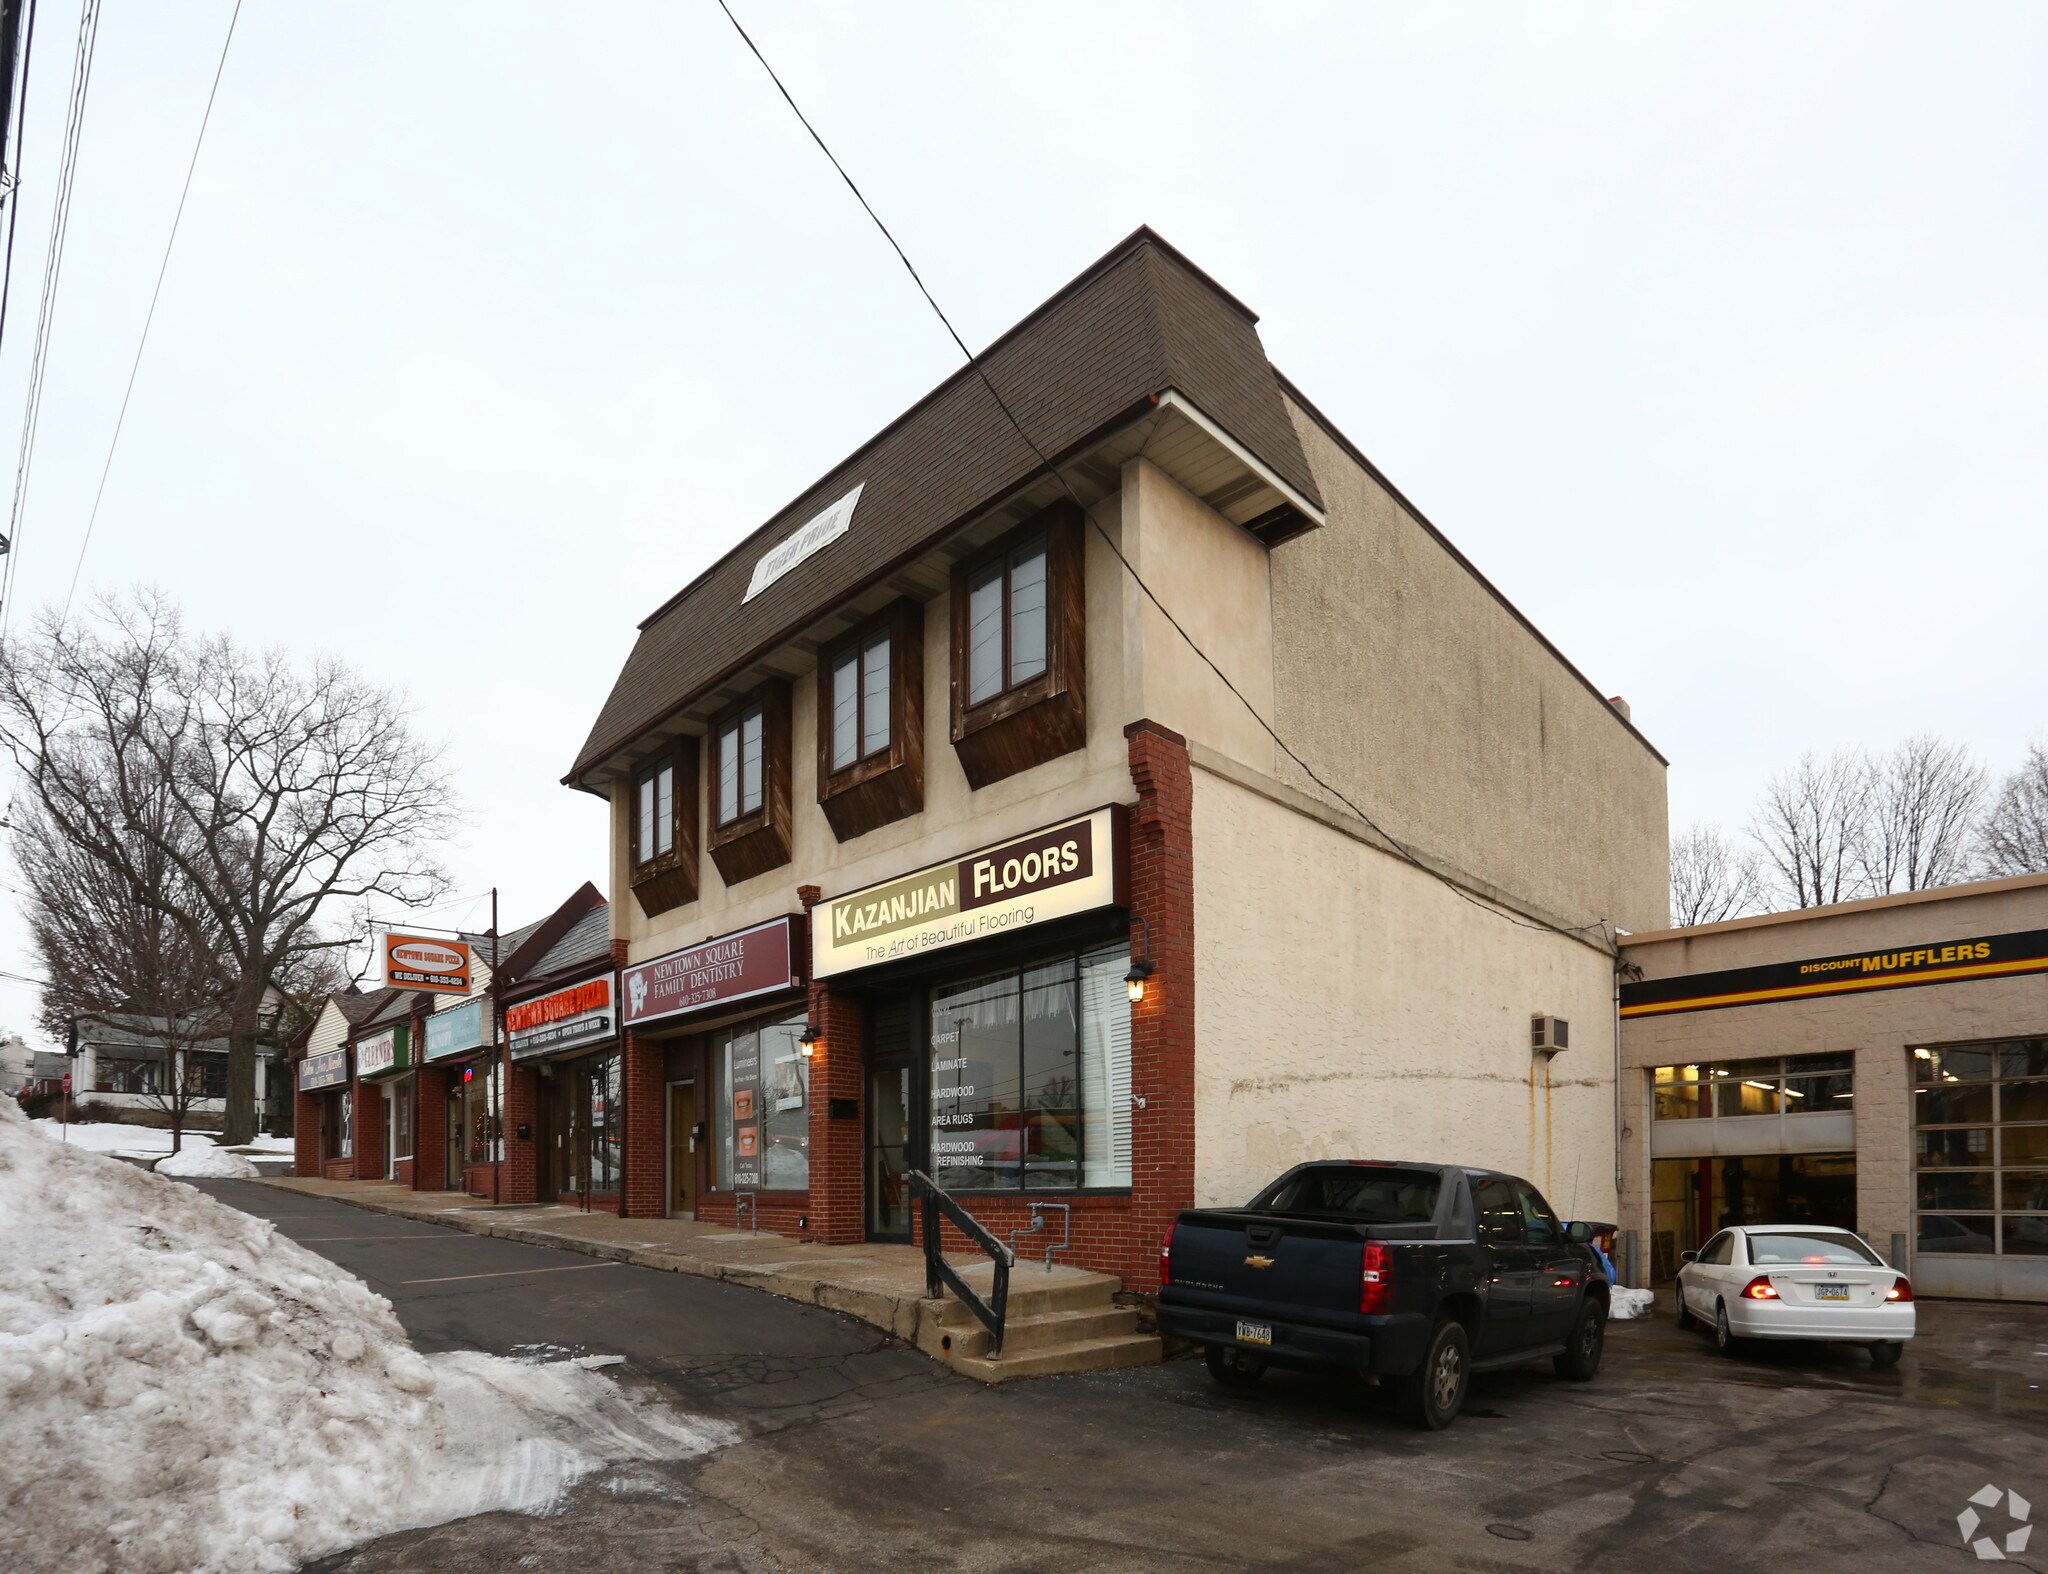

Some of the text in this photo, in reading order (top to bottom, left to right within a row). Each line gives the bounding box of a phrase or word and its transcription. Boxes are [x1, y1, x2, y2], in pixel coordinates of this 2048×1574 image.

[835, 840, 1079, 938] KAZANJIAN FLOORS
[866, 905, 1035, 961] The Art of Beautiful Flooring
[396, 949, 460, 965] NEWTOWN SQUARE PIZZA
[654, 939, 744, 980] NEWTOWN SQUARE
[1800, 942, 1991, 974] DISCOUNT MUFFLERS
[394, 971, 403, 980] WE
[404, 972, 424, 982] DELIVER
[654, 960, 744, 999] FAMILY DENTISTRY
[679, 987, 717, 1007] 610-325-7308
[506, 1000, 543, 1033] NEWTOWN
[543, 989, 575, 1021] SQUARE
[562, 1026, 572, 1037] OPEN
[931, 1031, 960, 1046] CARPET
[931, 1058, 968, 1072] LAMINATE
[931, 1086, 975, 1099] HARDWOOD
[931, 1113, 974, 1126] AREA RUGS
[931, 1141, 975, 1153] HARDWOOD
[936, 1155, 984, 1166] REFINISHING
[1174, 1278, 1224, 1290] AVALANCHE
